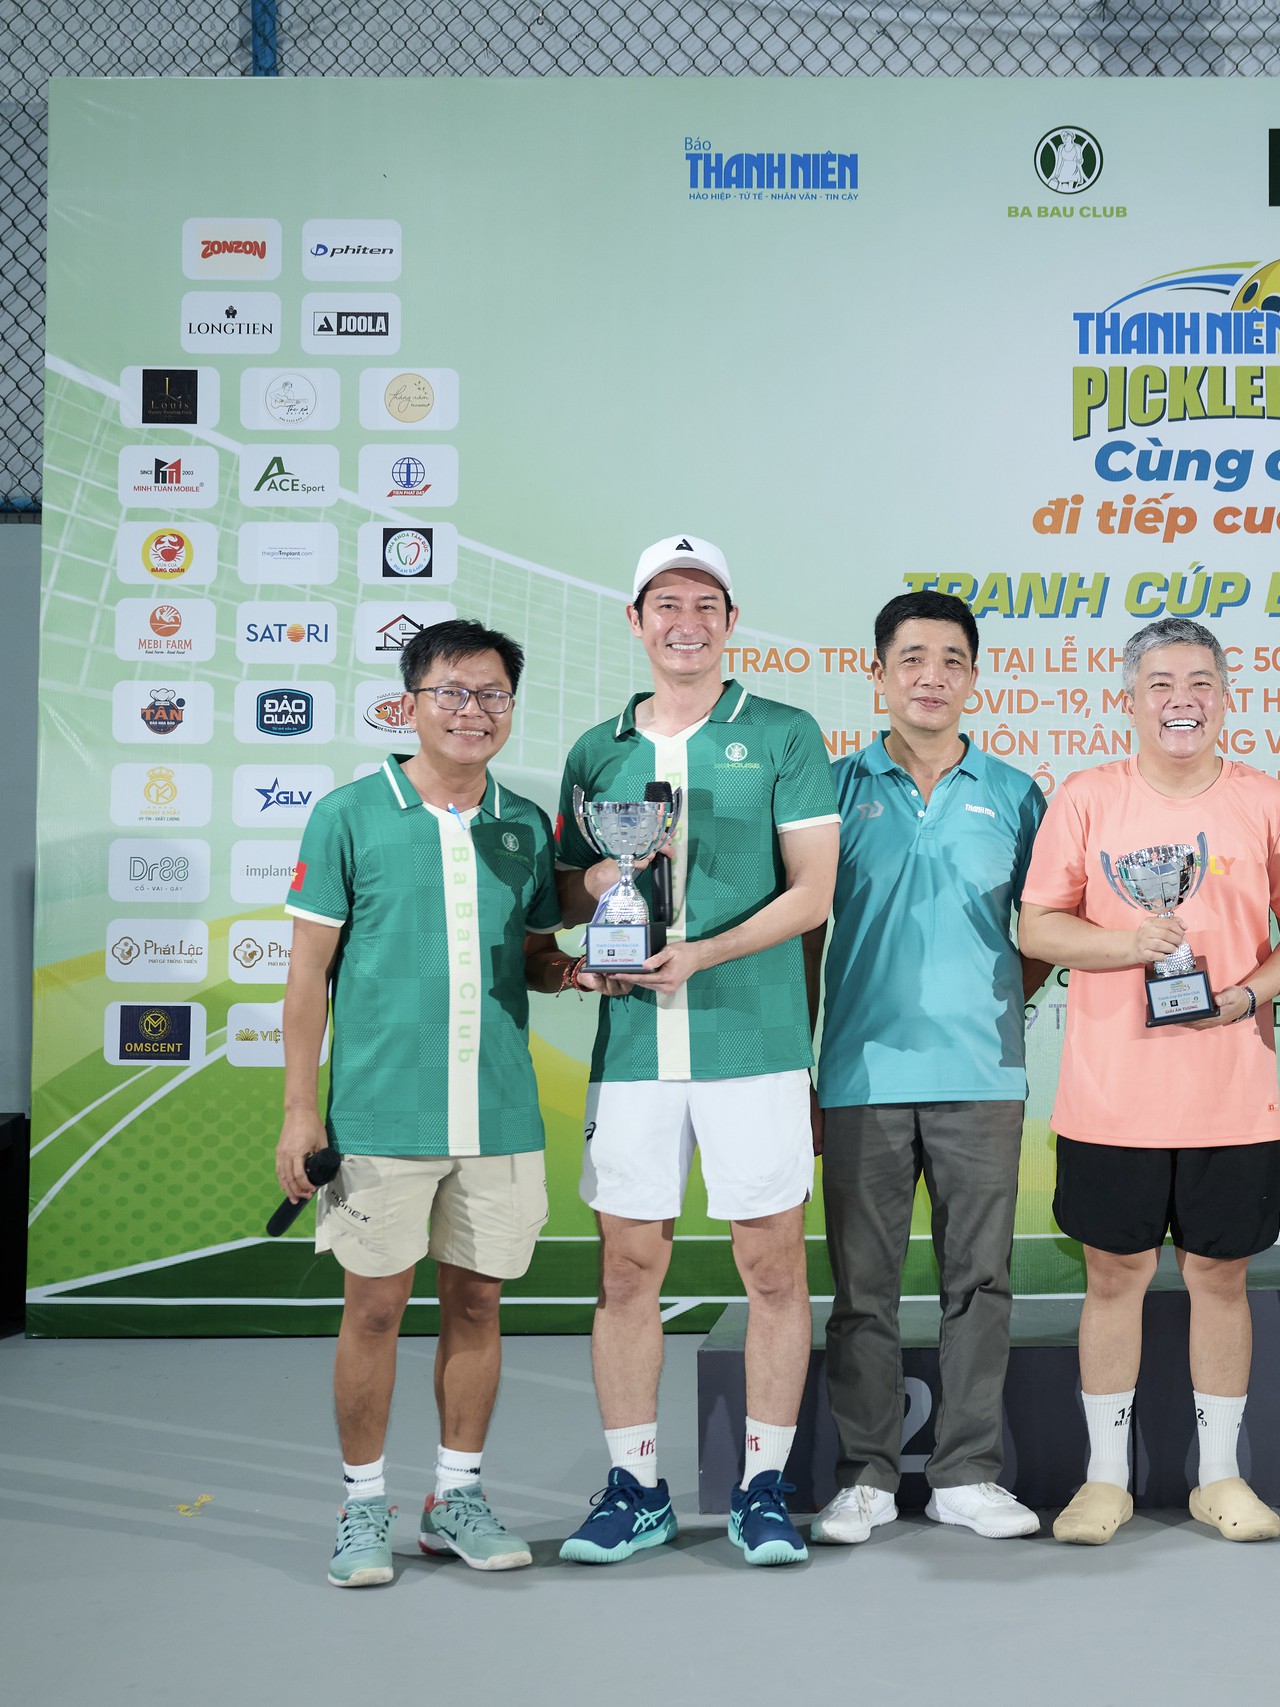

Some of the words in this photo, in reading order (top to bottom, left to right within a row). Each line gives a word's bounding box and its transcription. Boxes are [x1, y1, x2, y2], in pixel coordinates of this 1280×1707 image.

[684, 137, 712, 151] Báo
[686, 153, 786, 189] THANH
[791, 150, 858, 189] NIÊN
[1007, 206, 1033, 218] BA
[1037, 206, 1075, 218] BAU
[1078, 206, 1128, 218] CLUB
[201, 240, 266, 259] ZONZON
[329, 244, 394, 258] phiten
[188, 322, 273, 335] LONGTIEN
[339, 314, 387, 333] JOOLA
[1072, 311, 1192, 355] THANH
[151, 401, 189, 409] Louis
[1095, 437, 1254, 492] Cùng
[267, 479, 300, 492] ACE
[301, 483, 325, 494] Sport
[1033, 493, 1085, 534] đi
[1096, 492, 1198, 543] tiếp
[1124, 561, 1250, 618] CÚP
[246, 623, 329, 644] SATORI
[138, 638, 162, 650] MEBI
[166, 638, 192, 650] FARM
[724, 647, 811, 673] TRAO
[988, 647, 1034, 681] TẠI
[1045, 635, 1079, 673] LỄ
[1087, 647, 1124, 673] KH
[141, 705, 183, 721] TÂN
[264, 695, 306, 712] ĐẢO
[962, 688, 1091, 719] OVID-19,
[1048, 724, 1131, 756] TRÂN
[276, 791, 313, 805] GLV
[129, 856, 189, 881] Dr88
[144, 939, 175, 956] Phát
[125, 1042, 183, 1053] OMSCENT
